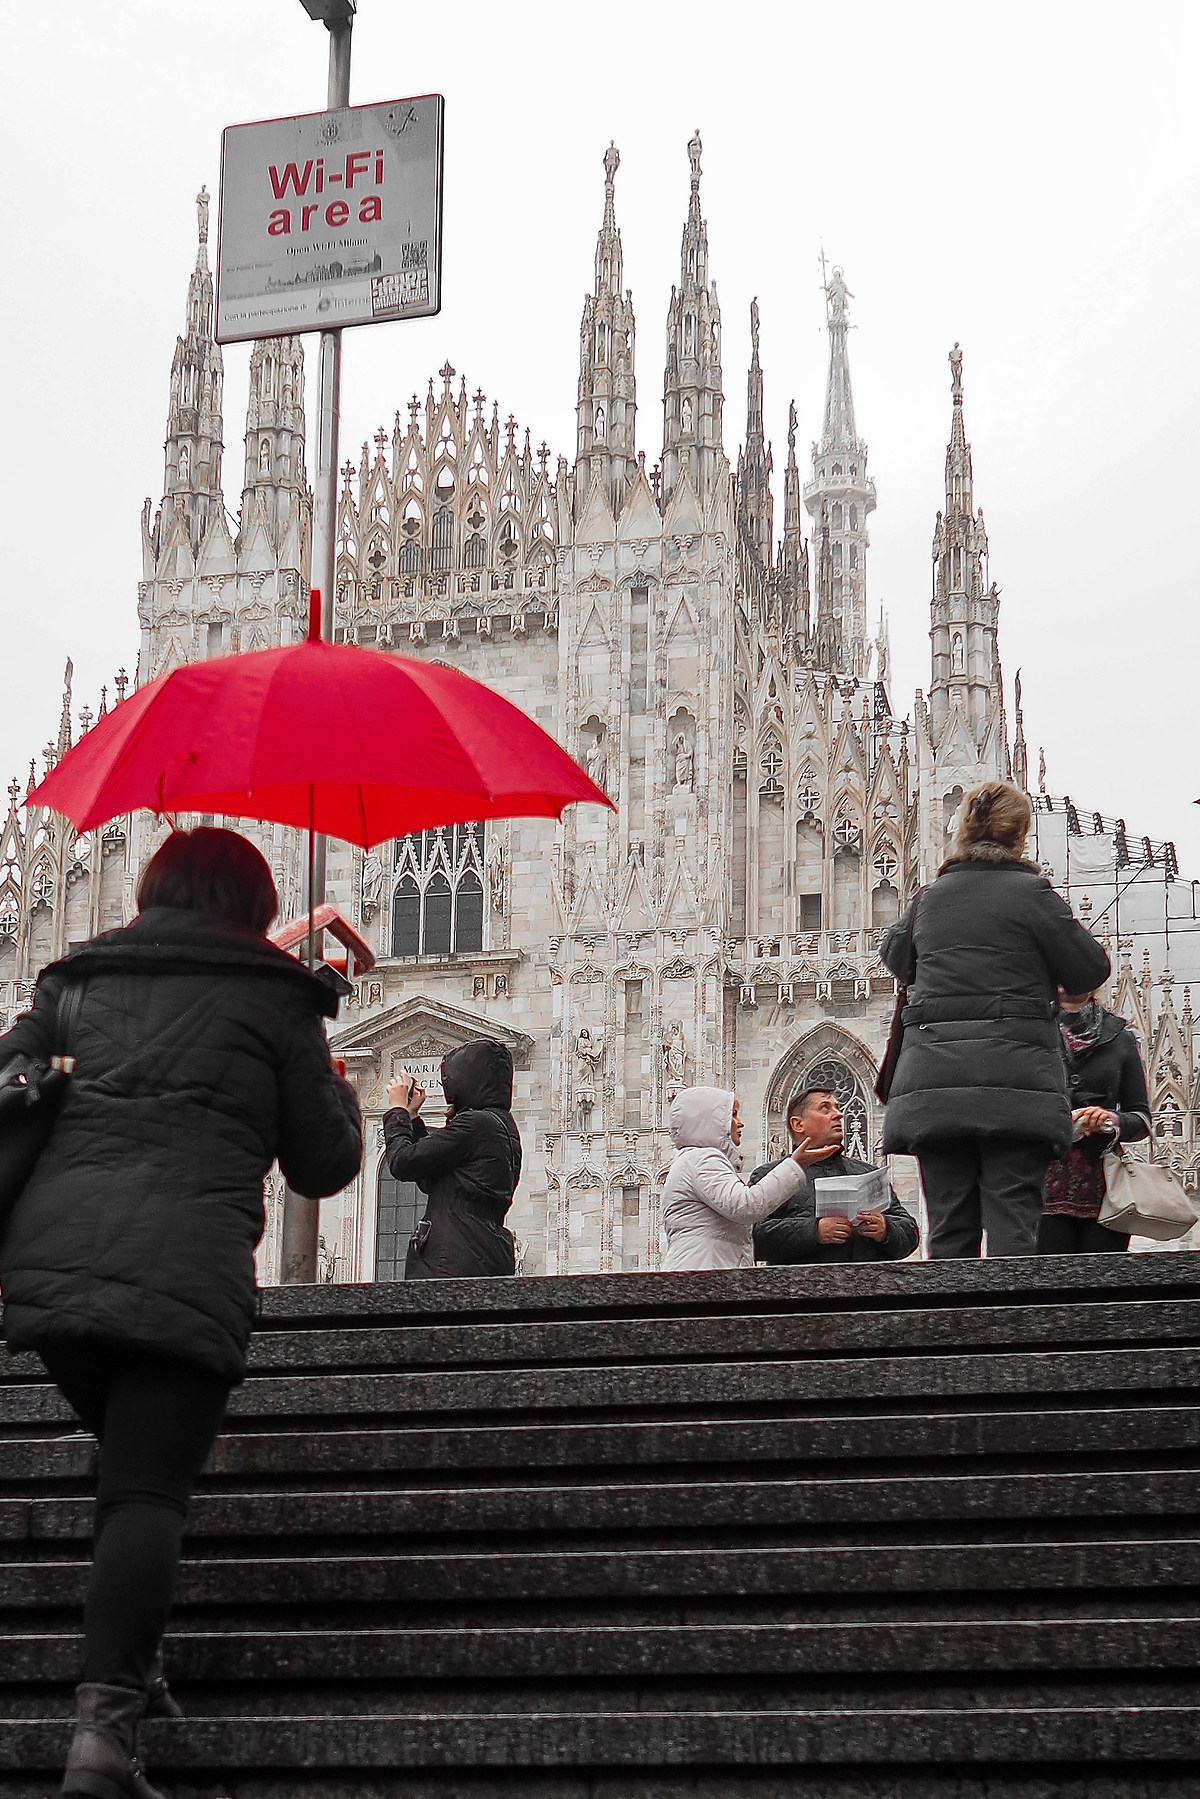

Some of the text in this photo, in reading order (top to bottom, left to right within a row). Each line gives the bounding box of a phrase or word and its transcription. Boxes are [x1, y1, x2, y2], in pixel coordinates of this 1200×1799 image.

[267, 149, 384, 200] Wi-Fi
[267, 195, 383, 236] area
[286, 246, 311, 256] Open
[339, 238, 368, 249] Milano
